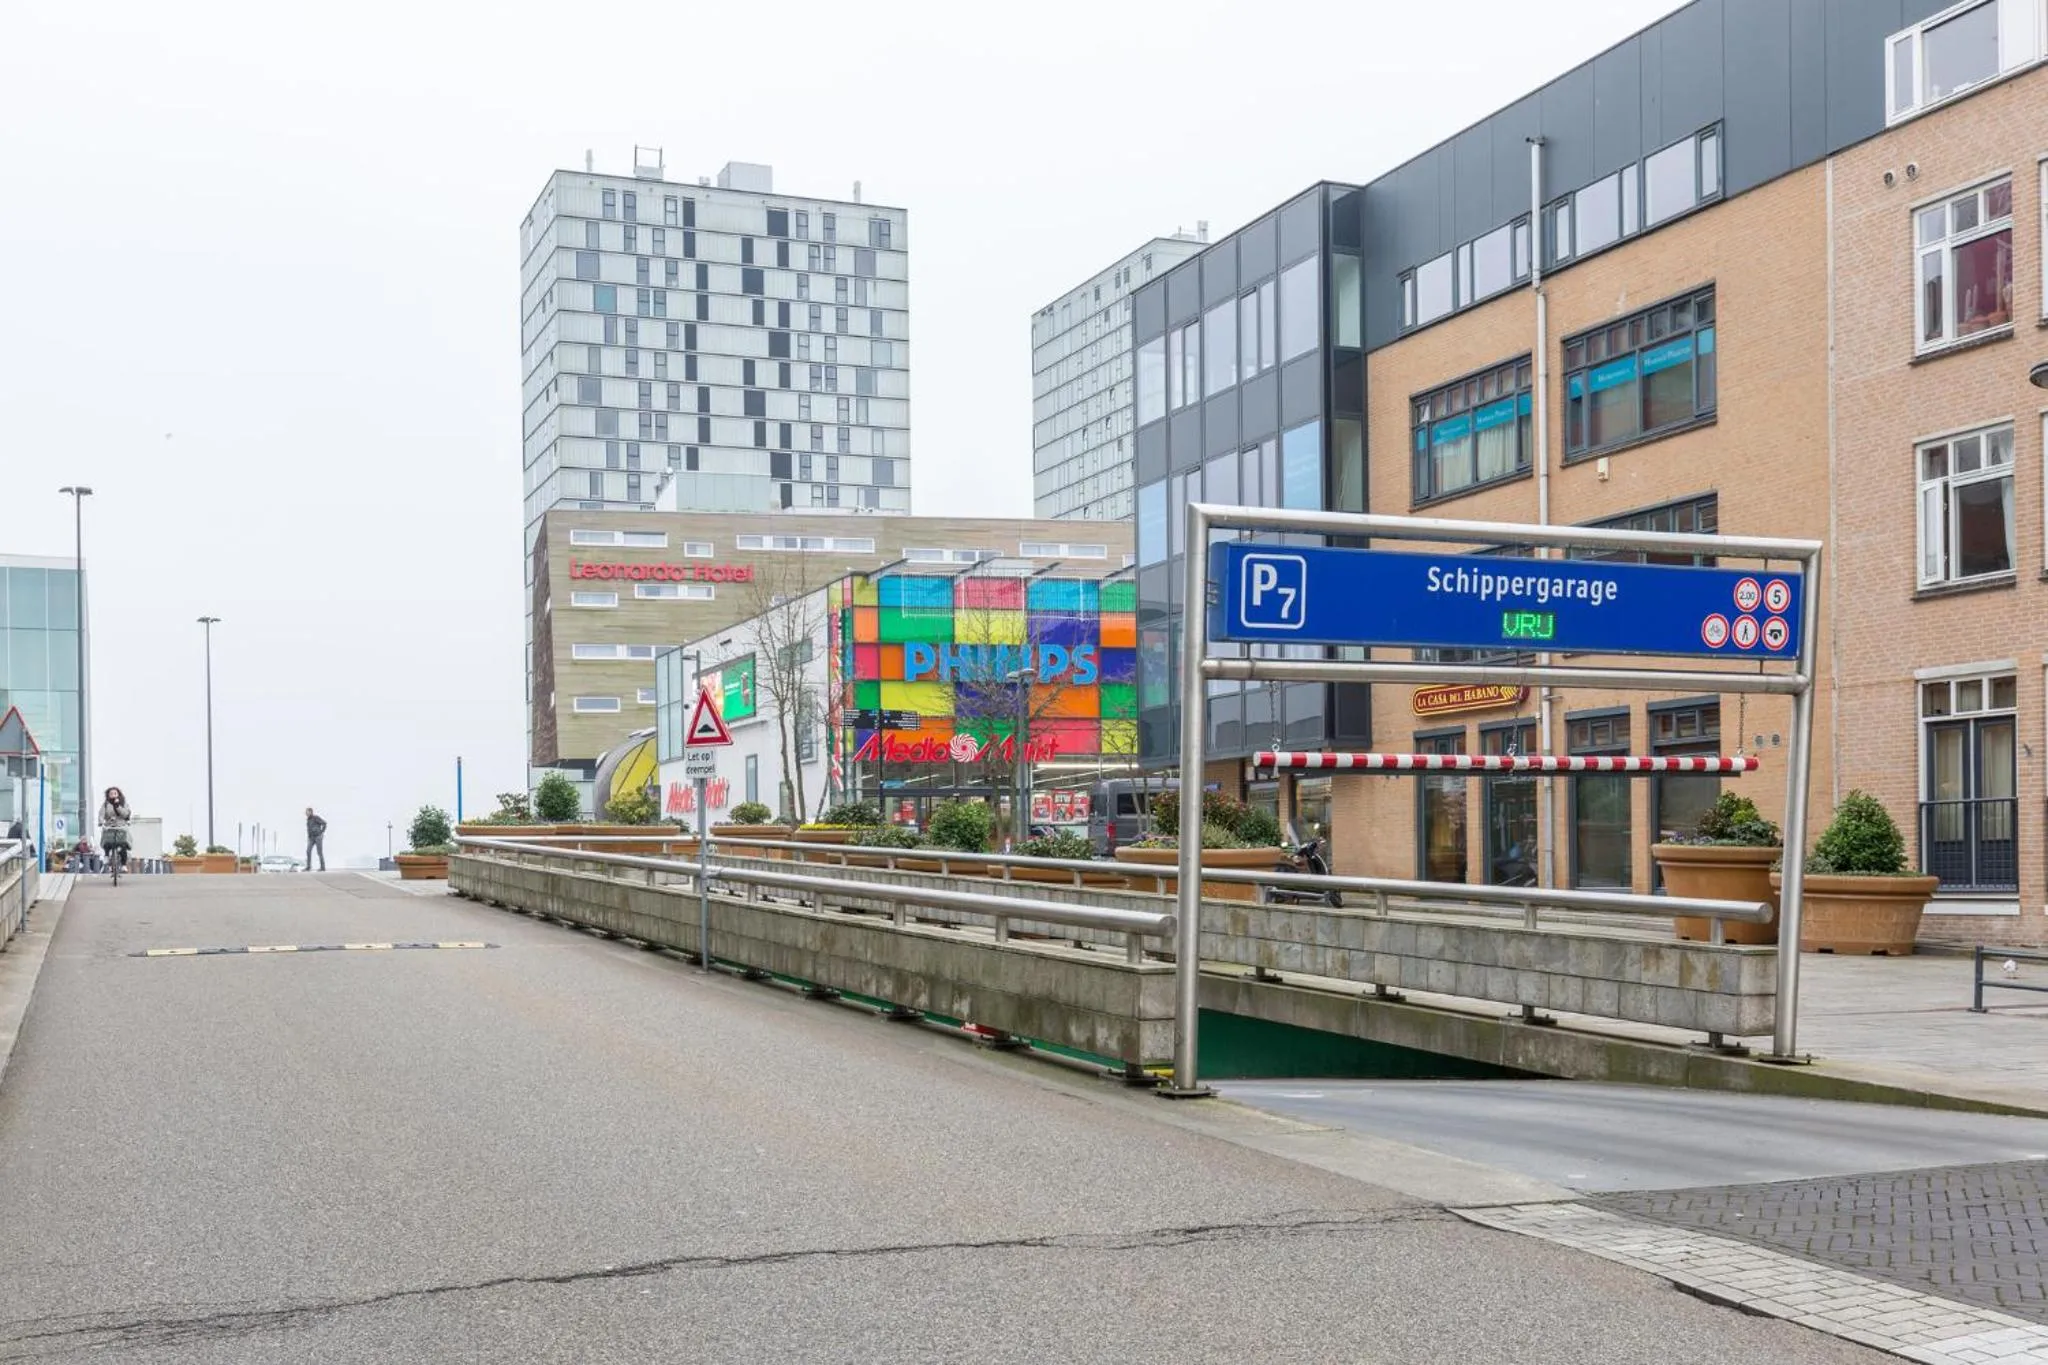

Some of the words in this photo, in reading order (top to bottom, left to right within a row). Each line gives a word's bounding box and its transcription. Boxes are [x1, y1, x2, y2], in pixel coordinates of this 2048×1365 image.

[570, 558, 684, 580] Leonardo
[693, 562, 754, 582] Hotel
[1427, 566, 1618, 605] Schippergarage
[1773, 589, 1781, 604] 5
[904, 641, 1099, 685] PHILIPS
[1418, 697, 1426, 707] LA
[1427, 693, 1448, 706] CASA
[1450, 692, 1463, 702] DEL
[1464, 686, 1499, 700] HABANO
[687, 751, 700, 761] Let
[852, 732, 950, 763] Media
